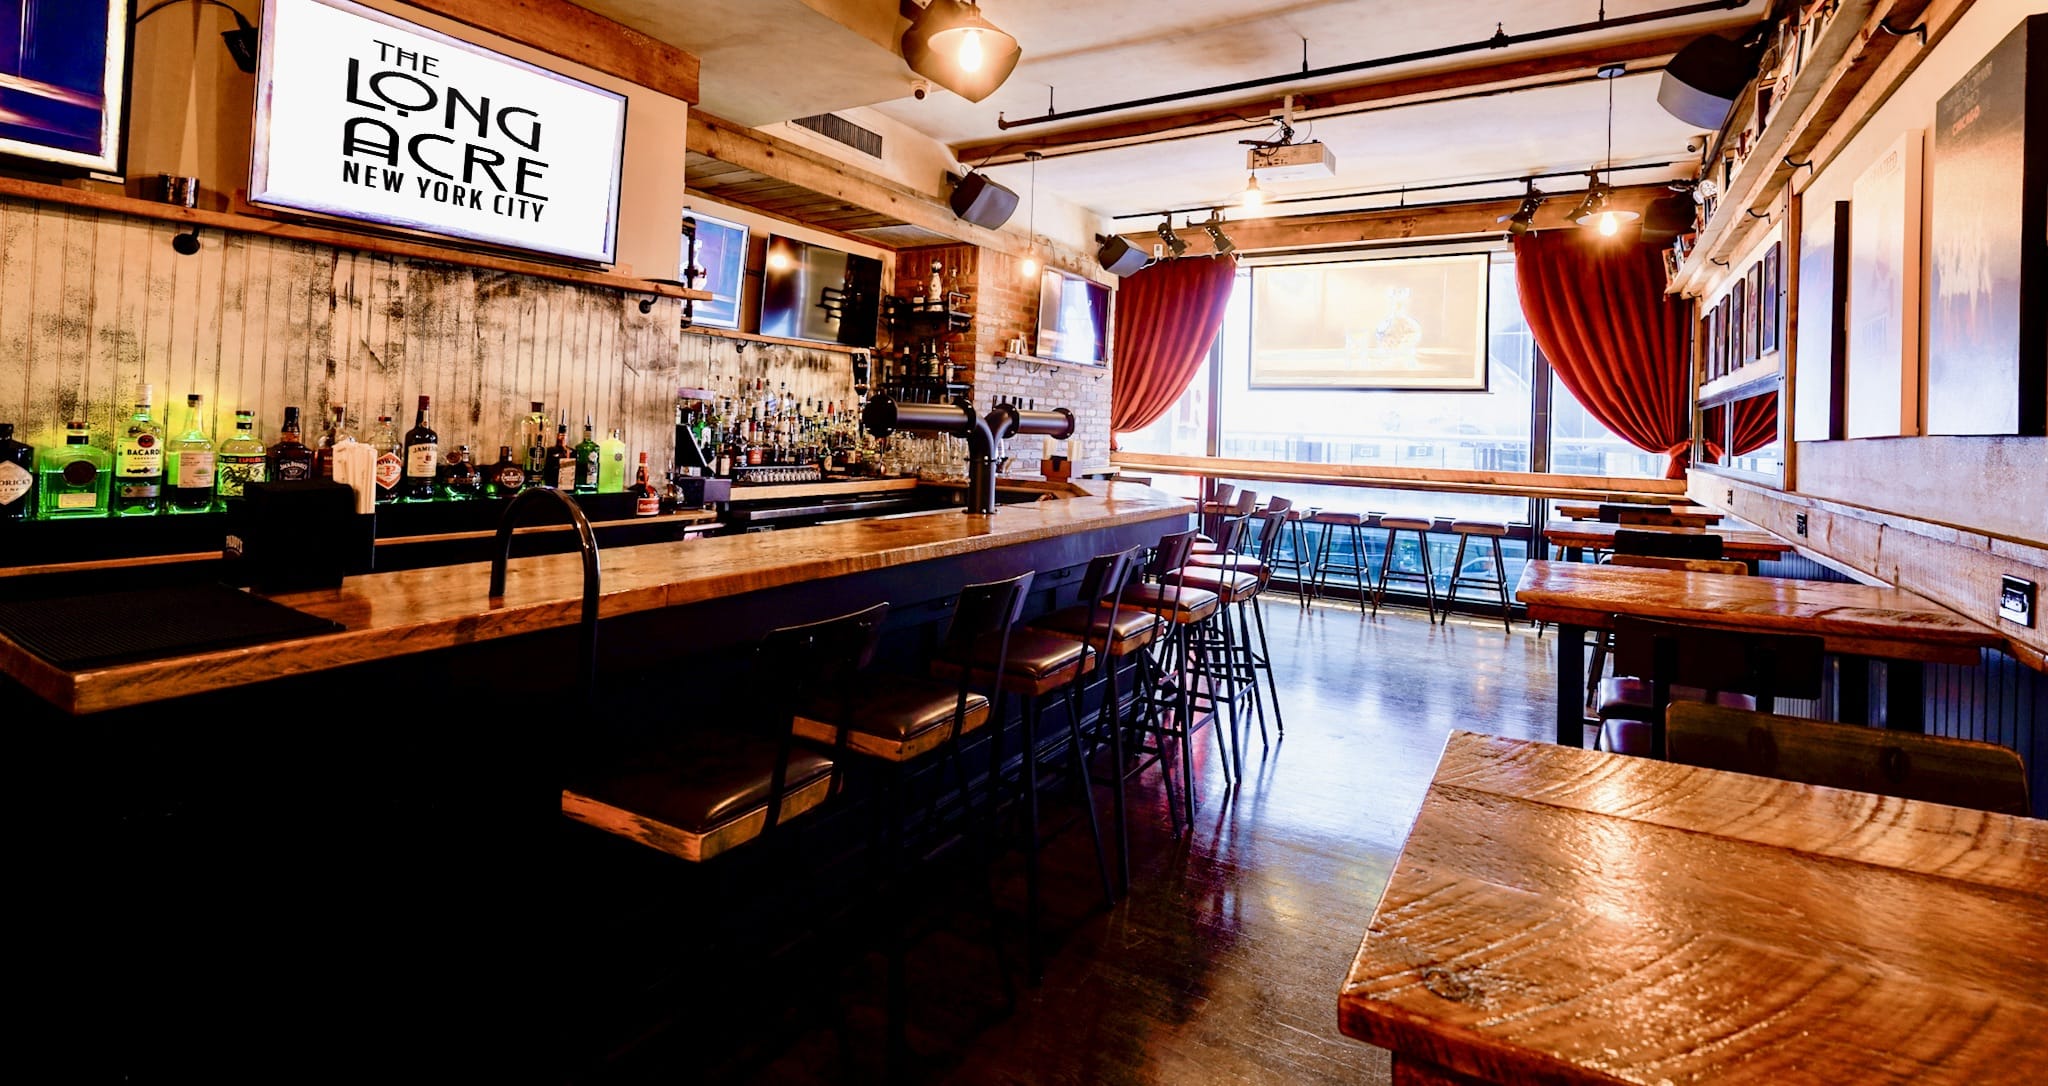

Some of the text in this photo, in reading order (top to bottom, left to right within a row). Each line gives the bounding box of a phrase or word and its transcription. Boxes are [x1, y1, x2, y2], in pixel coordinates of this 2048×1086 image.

[373, 40, 440, 78] THE
[346, 57, 541, 152] LONG
[343, 117, 549, 201] ACRE
[343, 160, 544, 223] NEW YORK CITY
